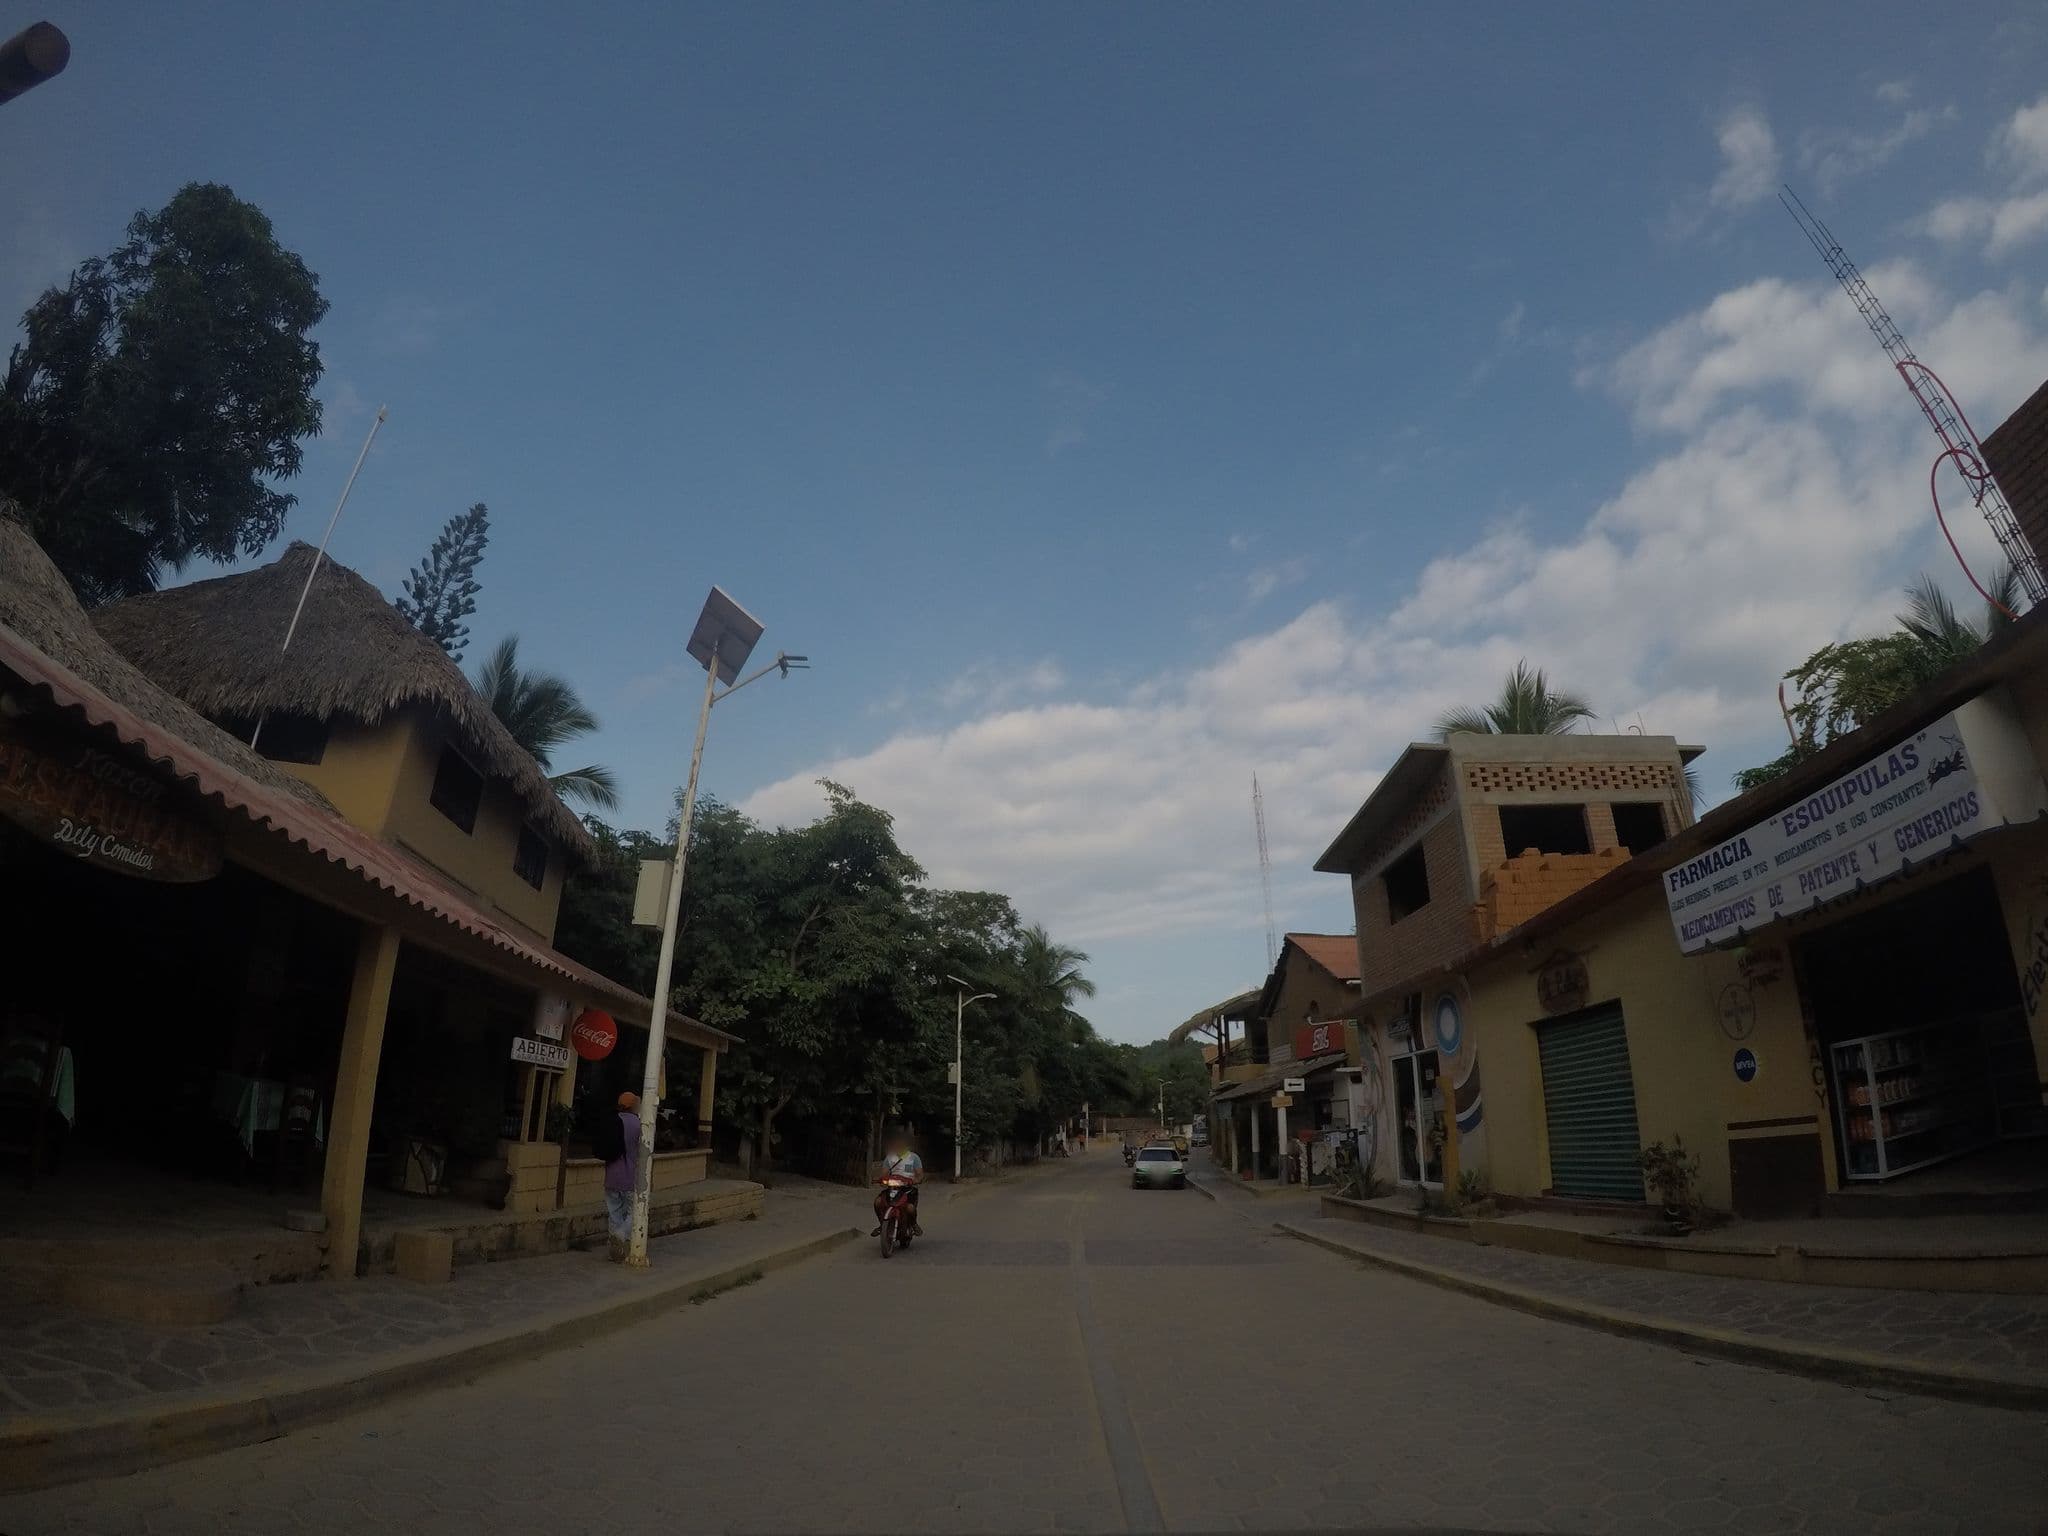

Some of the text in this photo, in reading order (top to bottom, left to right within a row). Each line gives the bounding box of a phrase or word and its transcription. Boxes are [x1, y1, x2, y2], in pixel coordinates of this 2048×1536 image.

[100, 835, 153, 871] Comidas
[1669, 838, 1752, 892] FARMACIA
[1775, 828, 1832, 866] MEDICAMENTOS
[1835, 821, 1848, 836] DE
[1851, 810, 1868, 829] USO
[1681, 791, 1980, 943] MEDICAMENTOS DE PATENTE Y GENERICOS
[517, 1039, 569, 1062] ABIERTO
